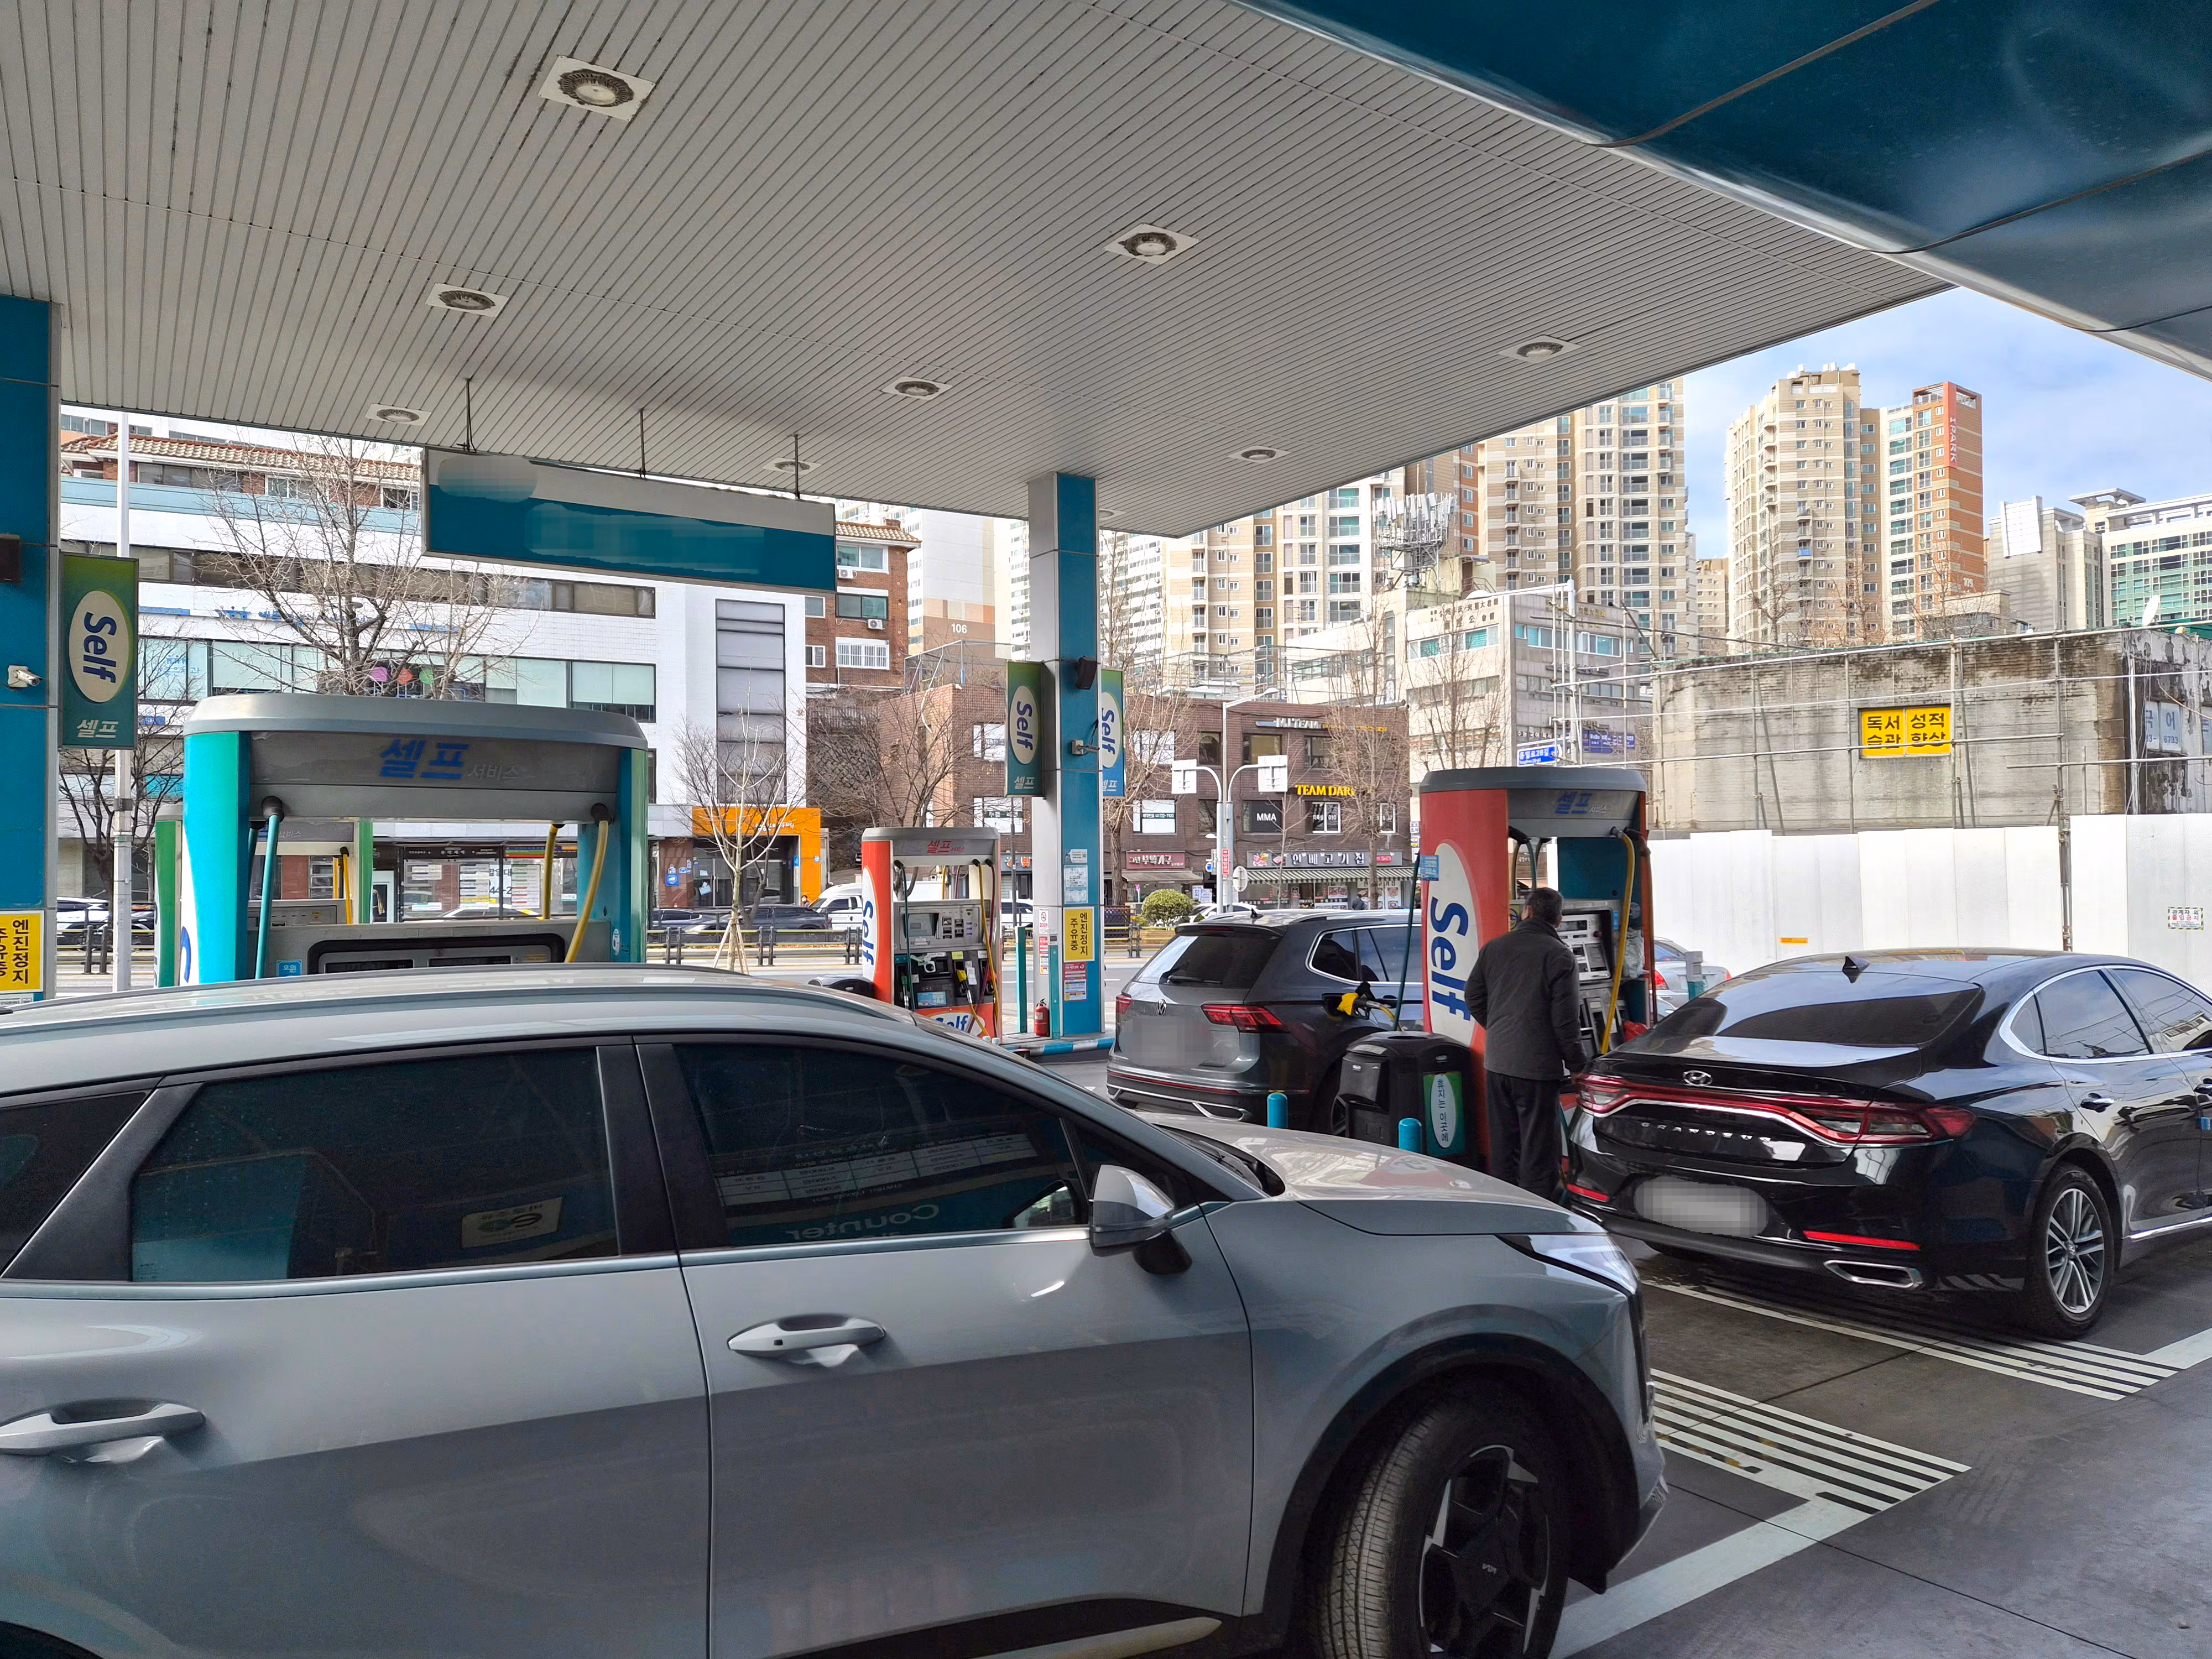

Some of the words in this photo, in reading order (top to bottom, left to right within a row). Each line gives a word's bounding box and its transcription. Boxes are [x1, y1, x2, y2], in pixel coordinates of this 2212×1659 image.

[951, 623, 968, 634] 106
[83, 610, 117, 684] Self
[76, 719, 119, 739] 셀프
[1016, 700, 1034, 751] Self
[1101, 709, 1115, 755] Self
[1866, 715, 1900, 731] 독서
[1910, 712, 1945, 729] 성적
[1866, 733, 1901, 749] 습관
[1910, 731, 1947, 748] 향상
[379, 738, 470, 780] 셀프
[467, 764, 521, 781] 서비스
[1014, 776, 1035, 789] 셀프
[1297, 785, 1326, 796] TEAM
[1554, 791, 1593, 815] 셀프
[1256, 813, 1277, 821] MMA
[927, 840, 952, 853] 셀프
[1070, 918, 1078, 951] 주유중
[1079, 912, 1088, 956] 엔진정지
[12, 919, 29, 984] 엔진정지
[1430, 896, 1471, 1022] Self
[1437, 1079, 1447, 1109] 휴지는
[1439, 1112, 1449, 1142] 이곳에
[1641, 1121, 1771, 1143] GRANDEUR
